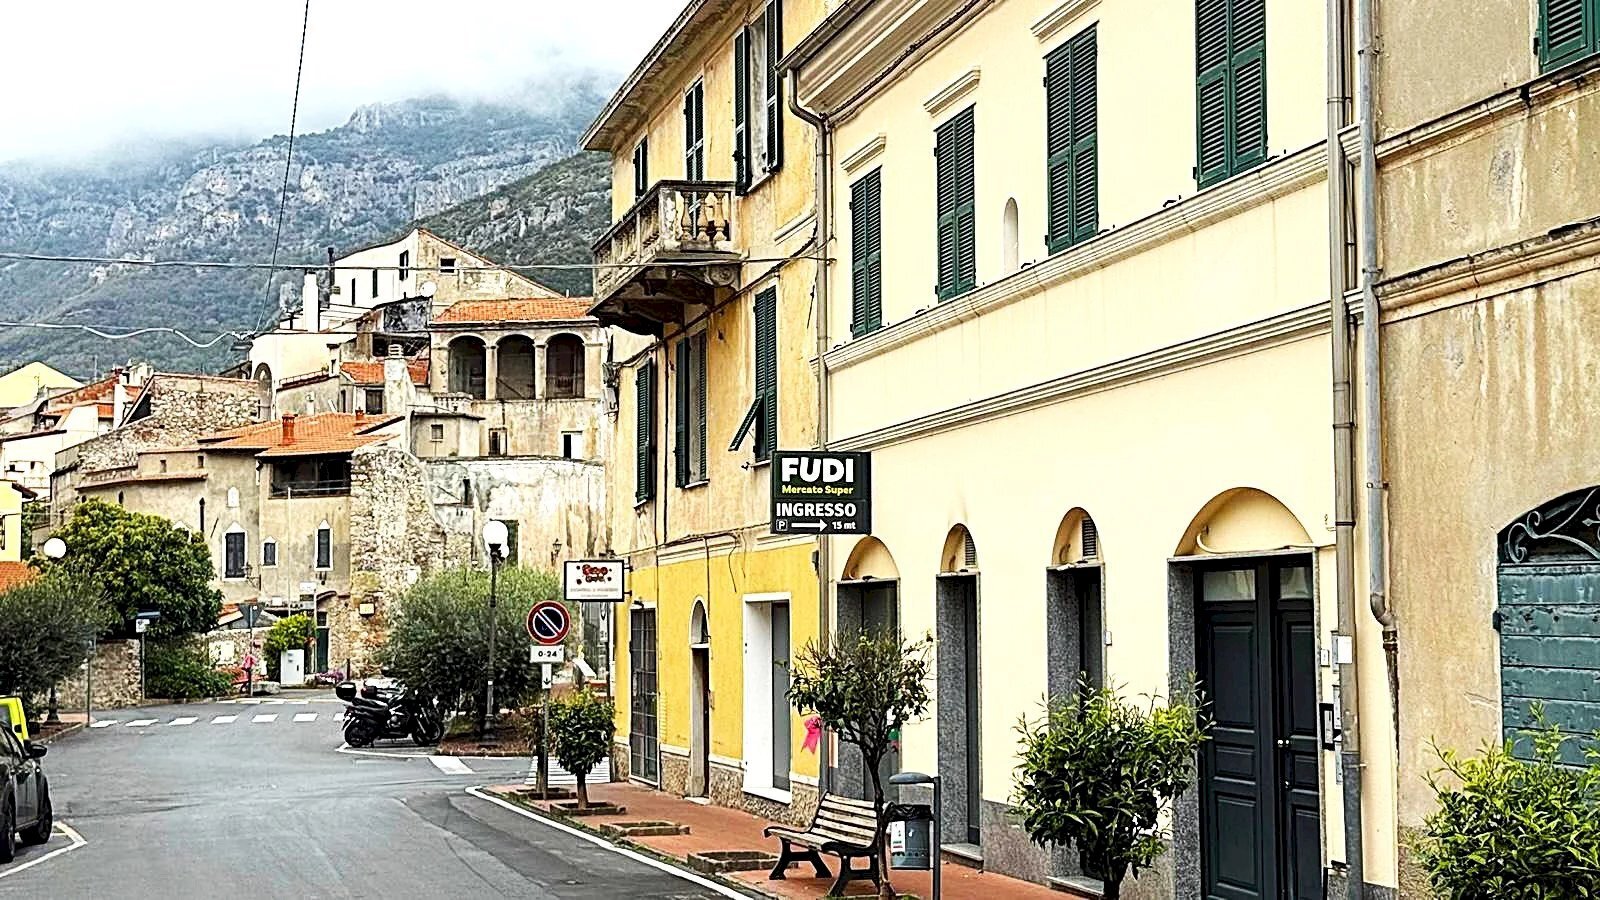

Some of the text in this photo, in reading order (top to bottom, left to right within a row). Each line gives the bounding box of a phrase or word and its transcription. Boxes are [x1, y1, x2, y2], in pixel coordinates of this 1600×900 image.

[781, 457, 854, 482] FUDI
[781, 485, 854, 496] Mercato Super
[776, 502, 857, 517] INGRESSO
[777, 520, 856, 530] P 15 mt
